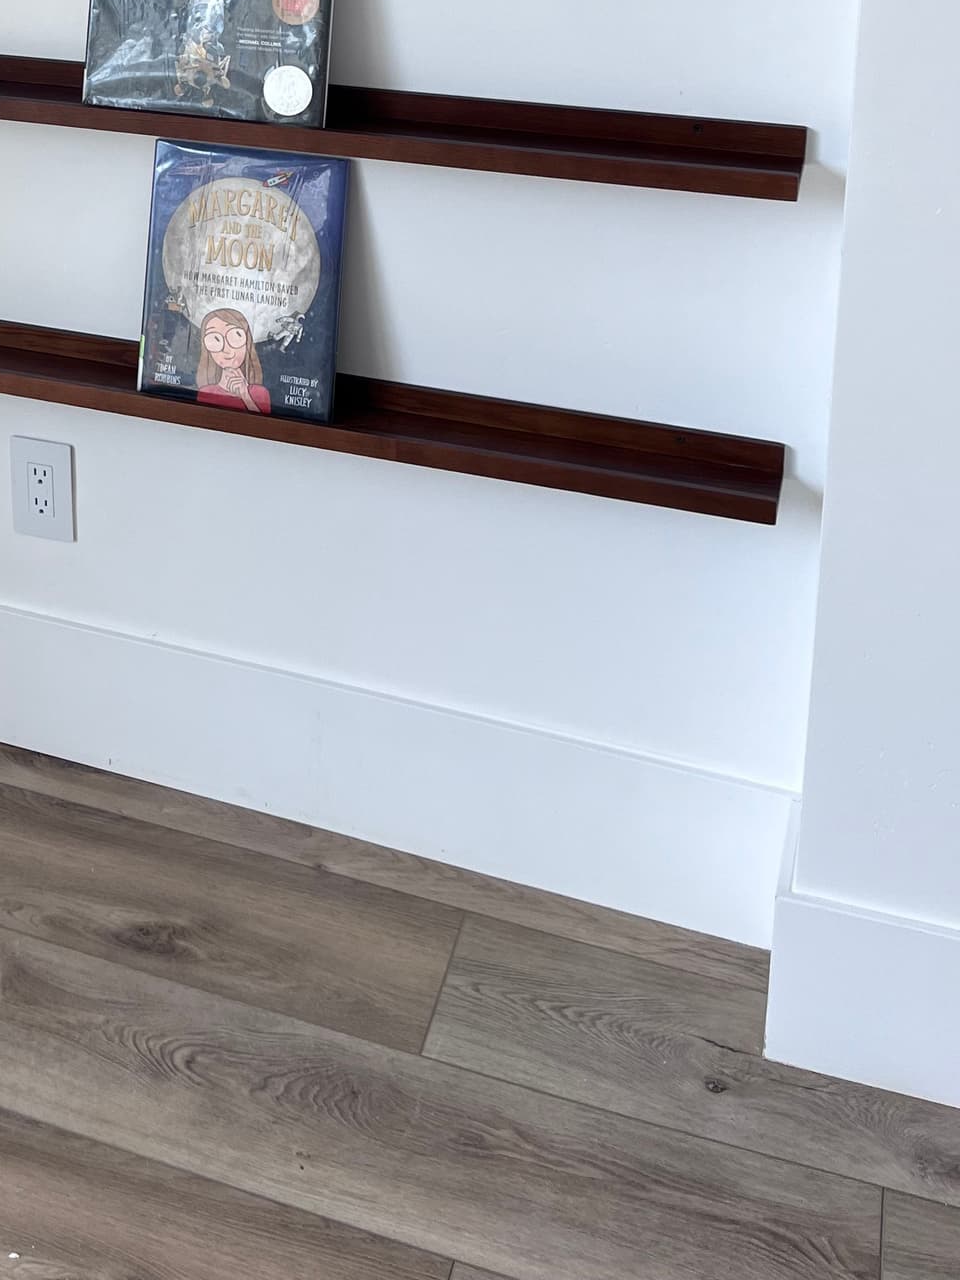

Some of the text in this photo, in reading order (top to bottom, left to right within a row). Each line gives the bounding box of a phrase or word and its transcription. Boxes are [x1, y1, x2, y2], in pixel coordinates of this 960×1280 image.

[188, 189, 301, 241] MARGARET
[221, 221, 262, 239] AND THE
[205, 235, 275, 272] MOON
[183, 271, 299, 296] HOW MARGARET HAMILTON SAVED
[195, 284, 288, 308] THE FIRST LUNAR LANDING
[289, 385, 307, 397] LUCY
[310, 379, 319, 388] BY
[284, 394, 312, 408] KNISLEY
